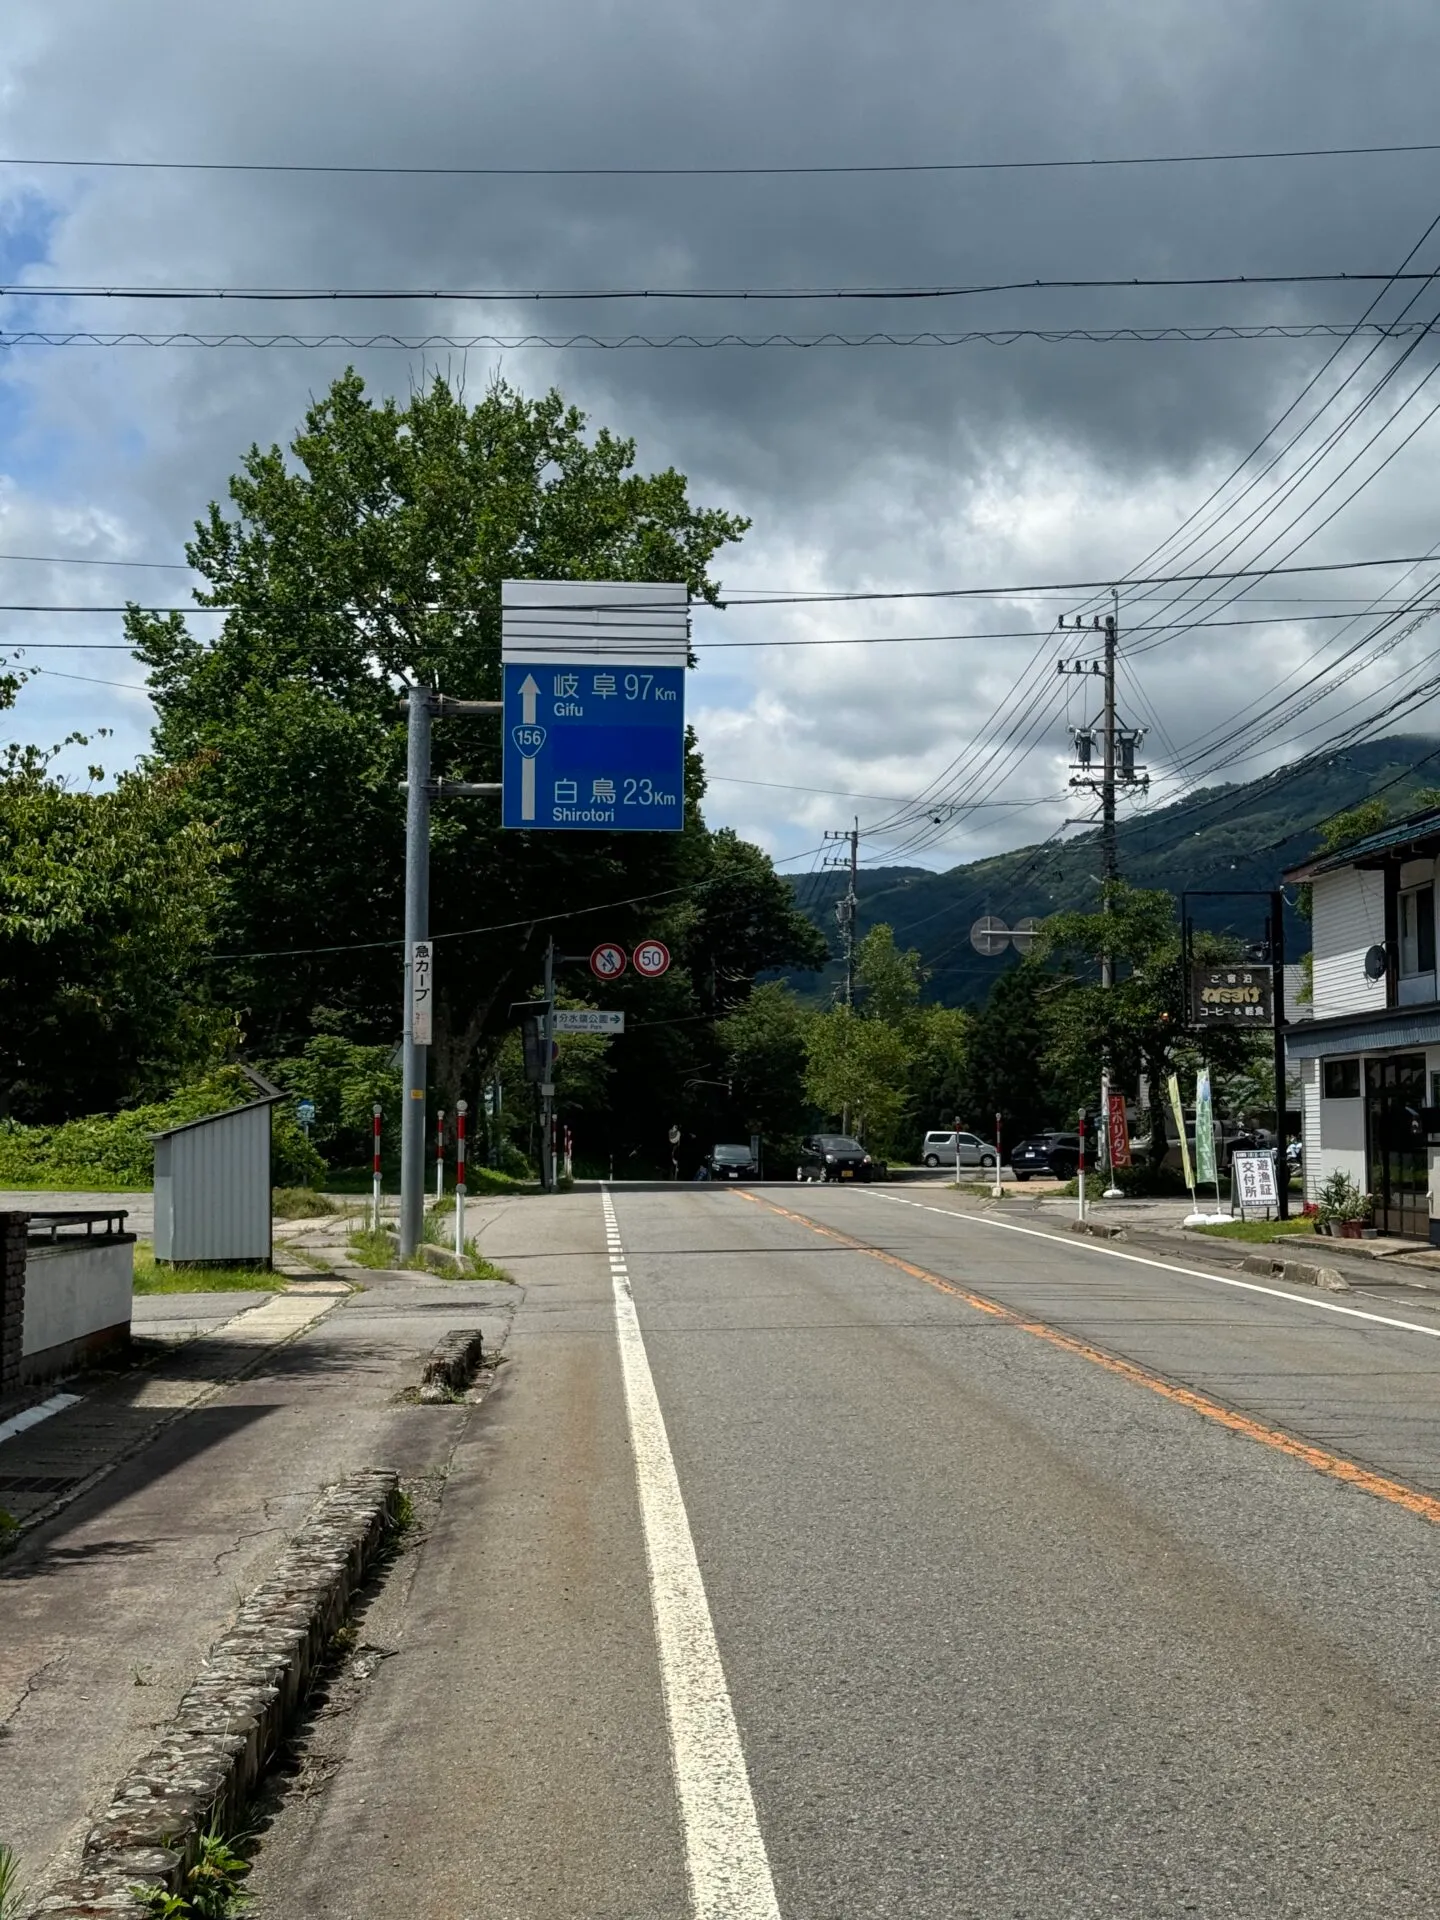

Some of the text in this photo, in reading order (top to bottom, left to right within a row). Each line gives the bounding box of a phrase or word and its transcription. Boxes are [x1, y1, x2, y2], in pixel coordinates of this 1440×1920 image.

[554, 673, 618, 700] 岐阜
[553, 702, 583, 717] Gifu
[517, 730, 542, 745] 156
[554, 778, 617, 804] 白鳥
[552, 808, 615, 822] Shirotori
[641, 951, 662, 967] 50
[414, 945, 430, 1002] 急カーブ
[1242, 1161, 1257, 1198] 交付所
[1257, 1159, 1273, 1196] 遊漁証
